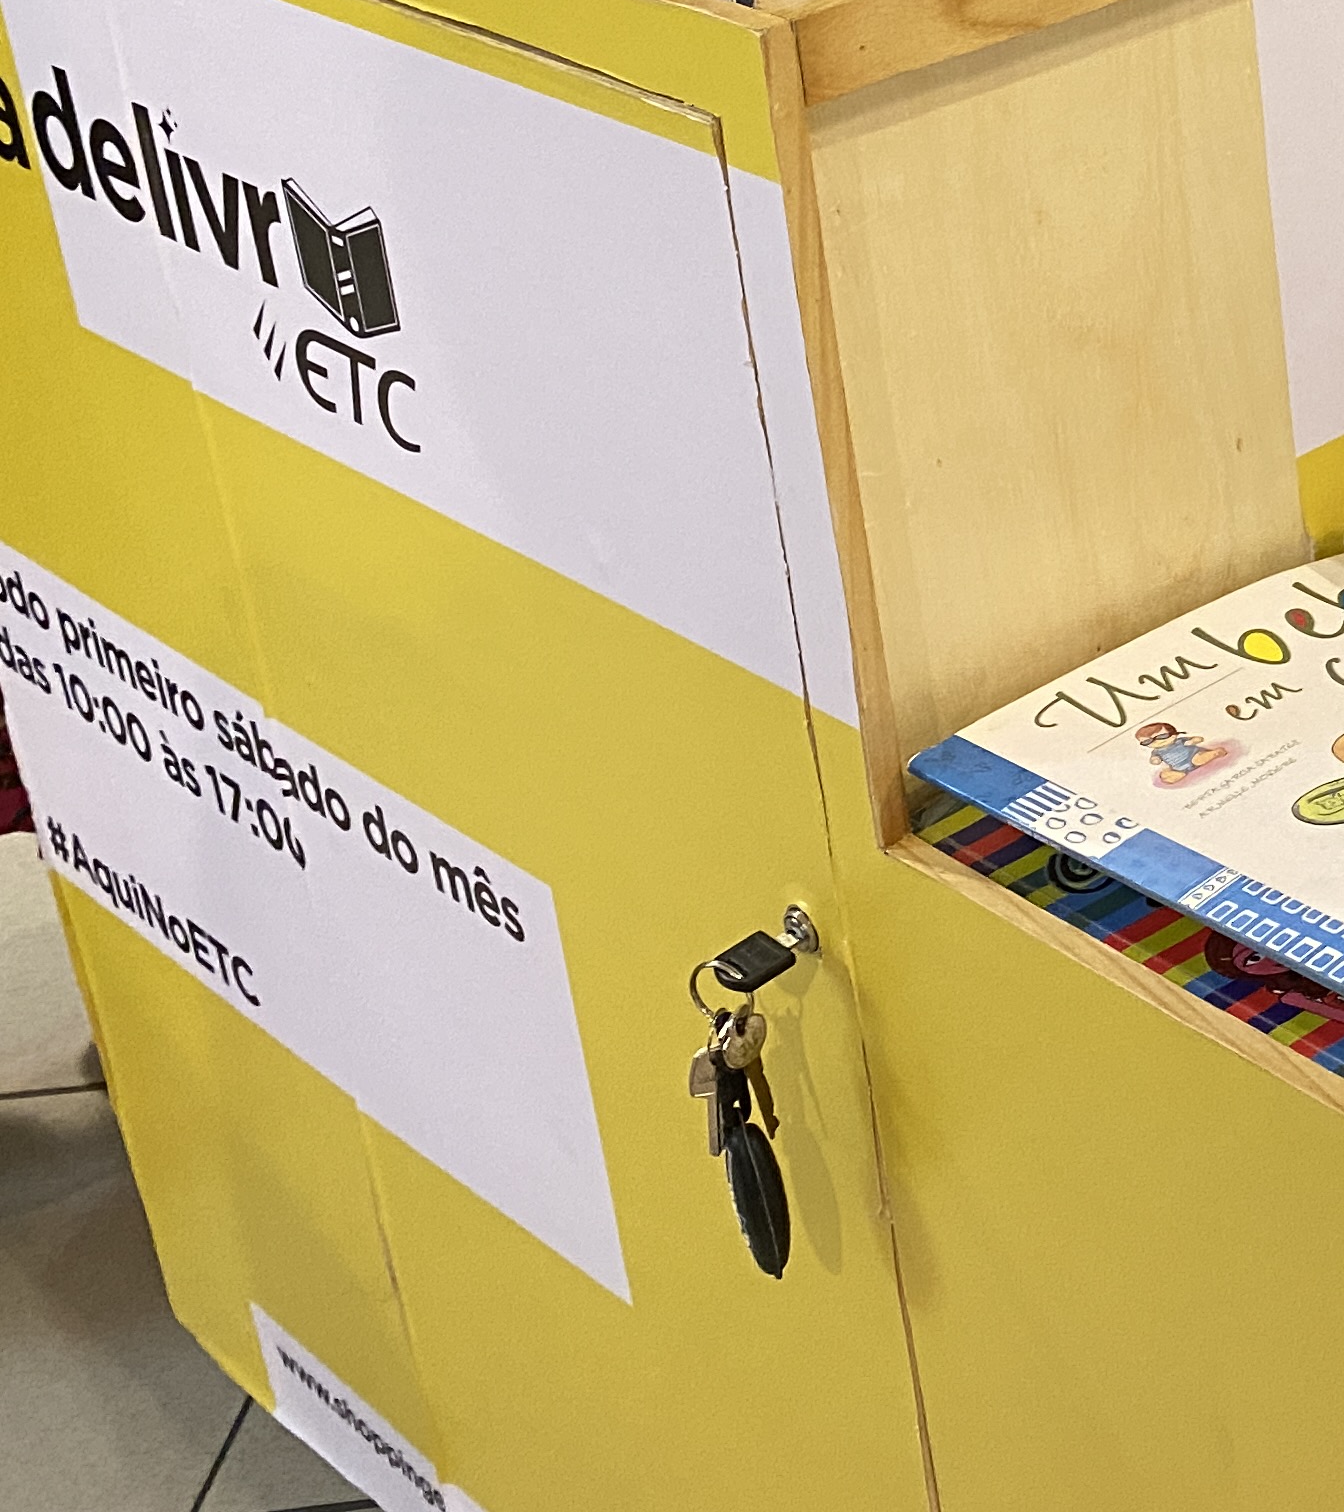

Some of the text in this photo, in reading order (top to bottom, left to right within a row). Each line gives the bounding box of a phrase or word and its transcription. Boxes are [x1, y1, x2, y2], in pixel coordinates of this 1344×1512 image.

[31, 64, 146, 226] de
[295, 328, 423, 454] ETC
[0, 626, 202, 797] das 10:00 às
[1034, 631, 1218, 734] Um
[1224, 678, 1303, 724] em
[56, 607, 527, 943] primeiro sábado do mês
[46, 815, 262, 1009] #AquiNoETC
